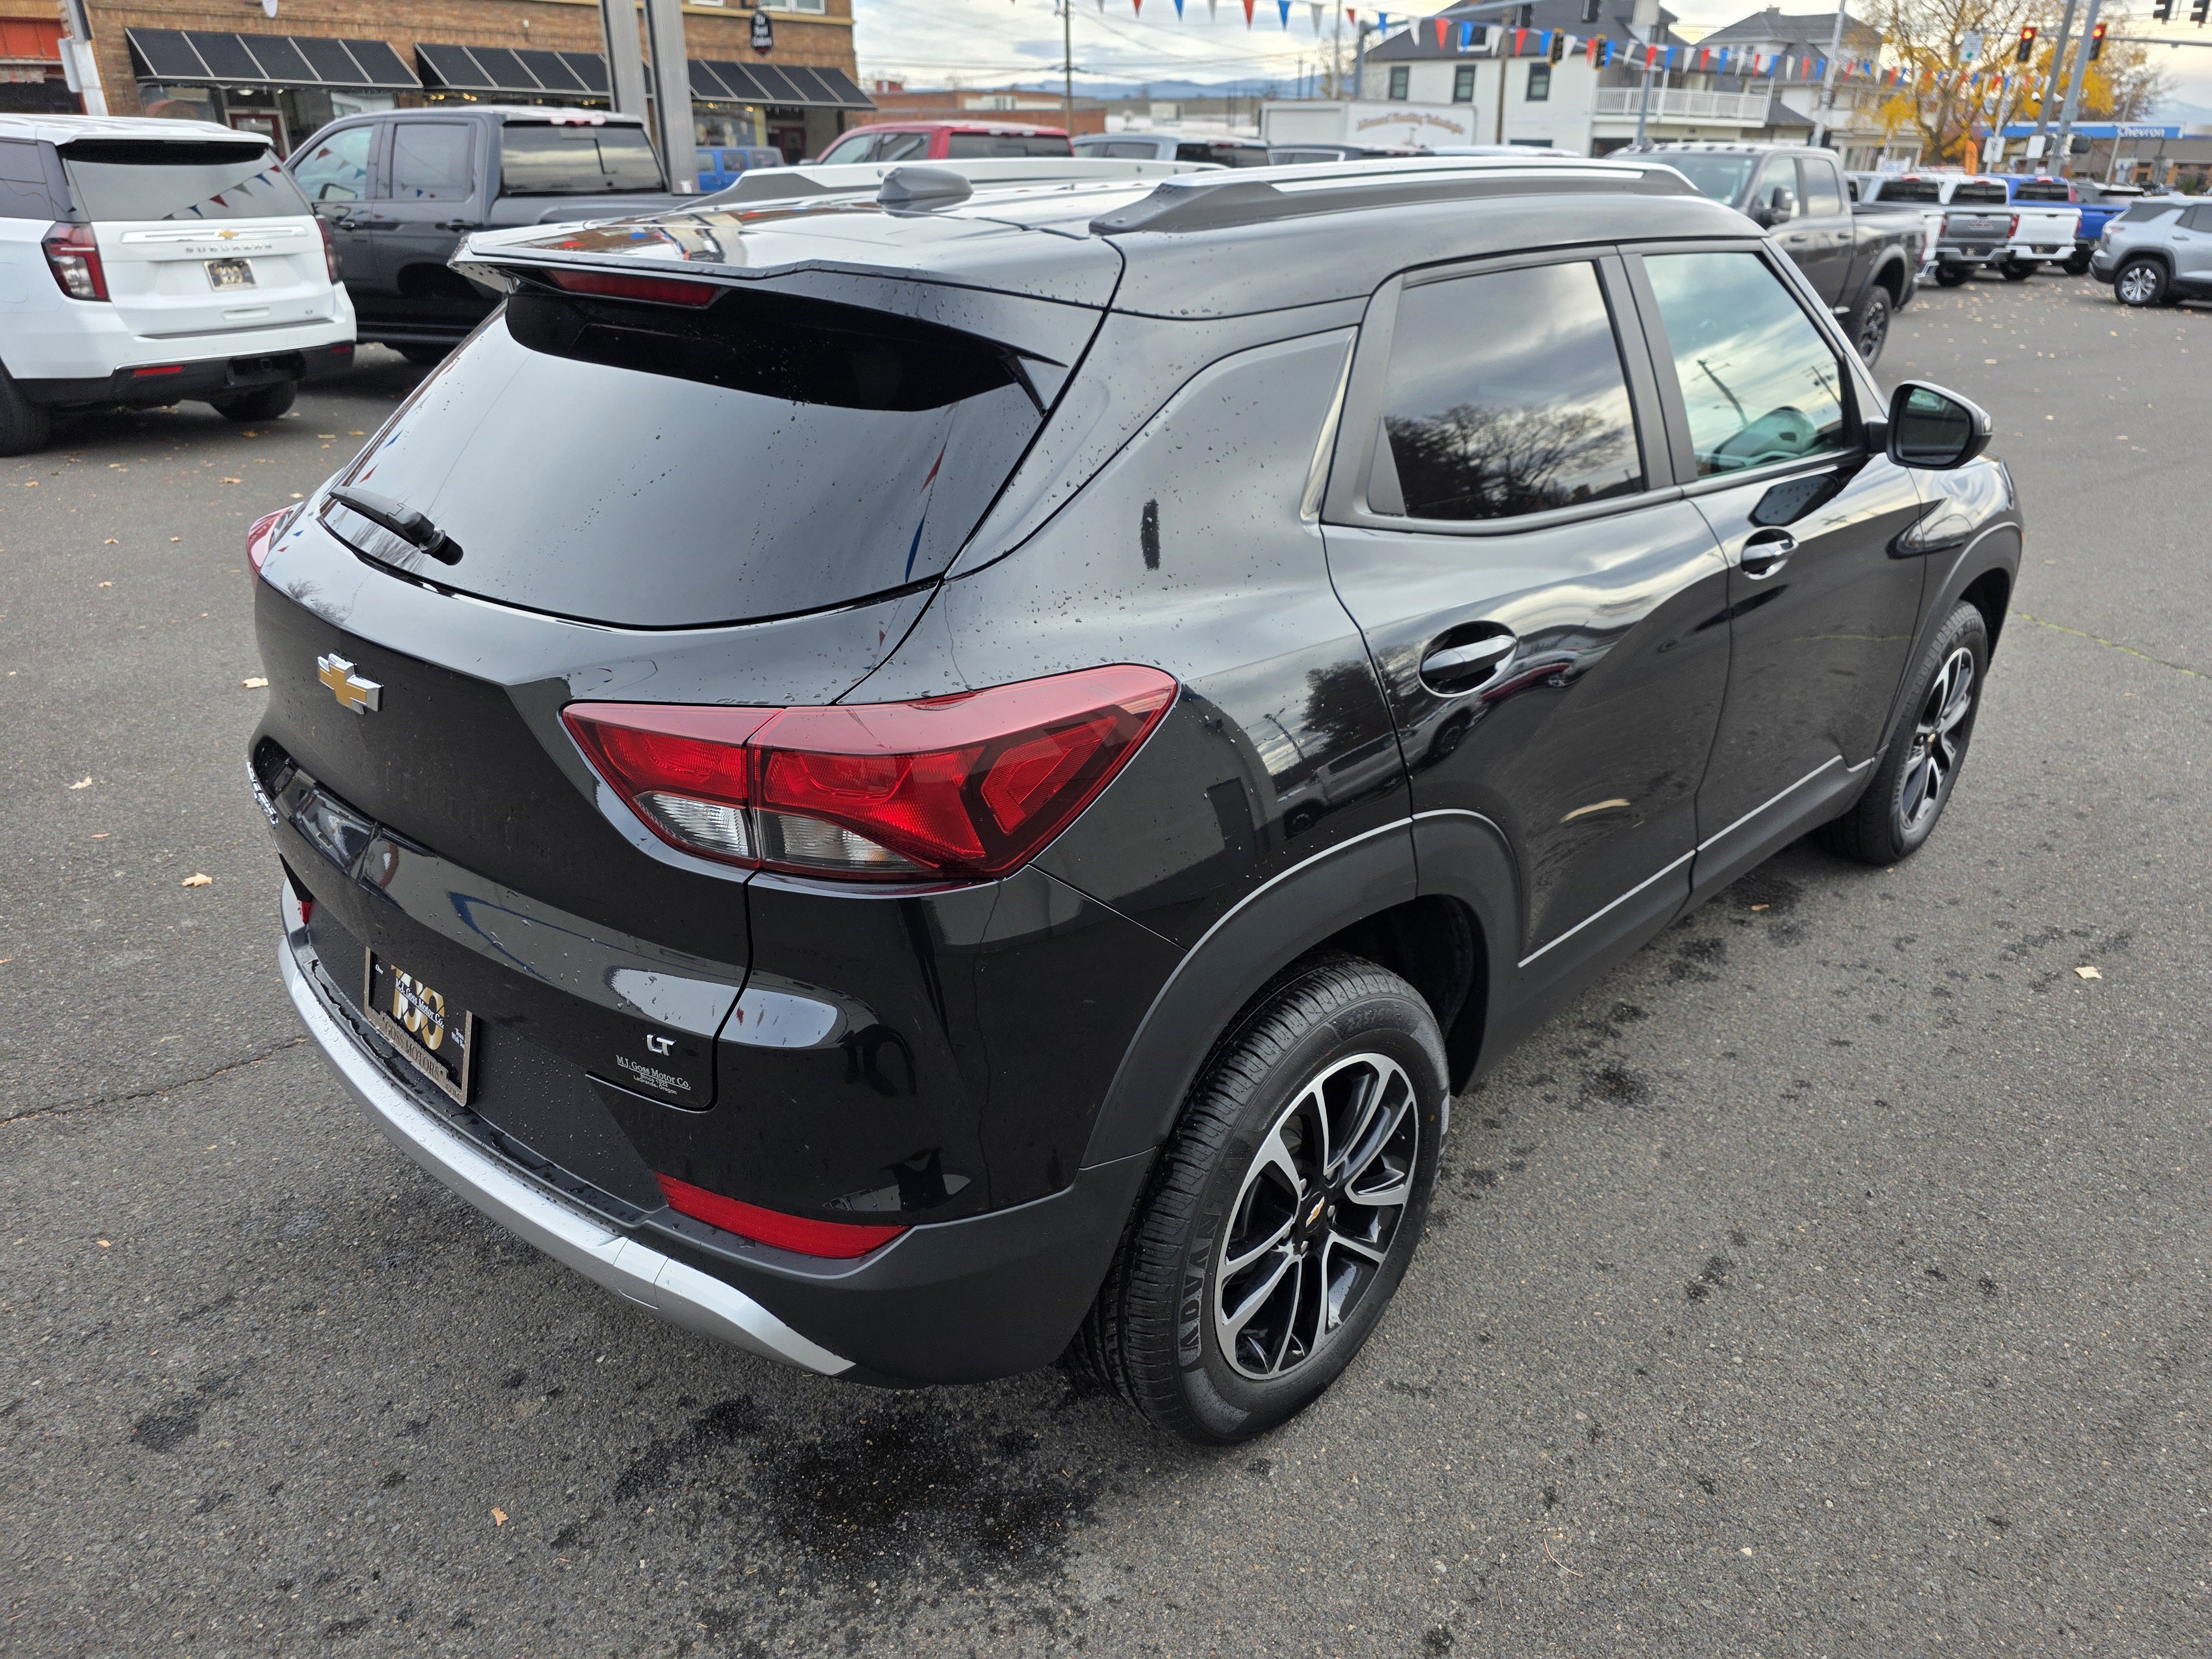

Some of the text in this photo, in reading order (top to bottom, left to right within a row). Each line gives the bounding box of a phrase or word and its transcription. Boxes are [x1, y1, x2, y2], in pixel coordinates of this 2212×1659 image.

[2117, 127, 2165, 137] Chevron
[406, 988, 418, 1004] Goss
[419, 998, 435, 1018] Motor
[435, 1013, 444, 1027] Co.
[385, 1021, 440, 1081] GOSS MOTORS
[646, 1034, 677, 1056] LT
[616, 1055, 691, 1089] M.J. Goss Motor Co.
[640, 1073, 654, 1082] Since
[659, 1084, 677, 1095] Oregon
